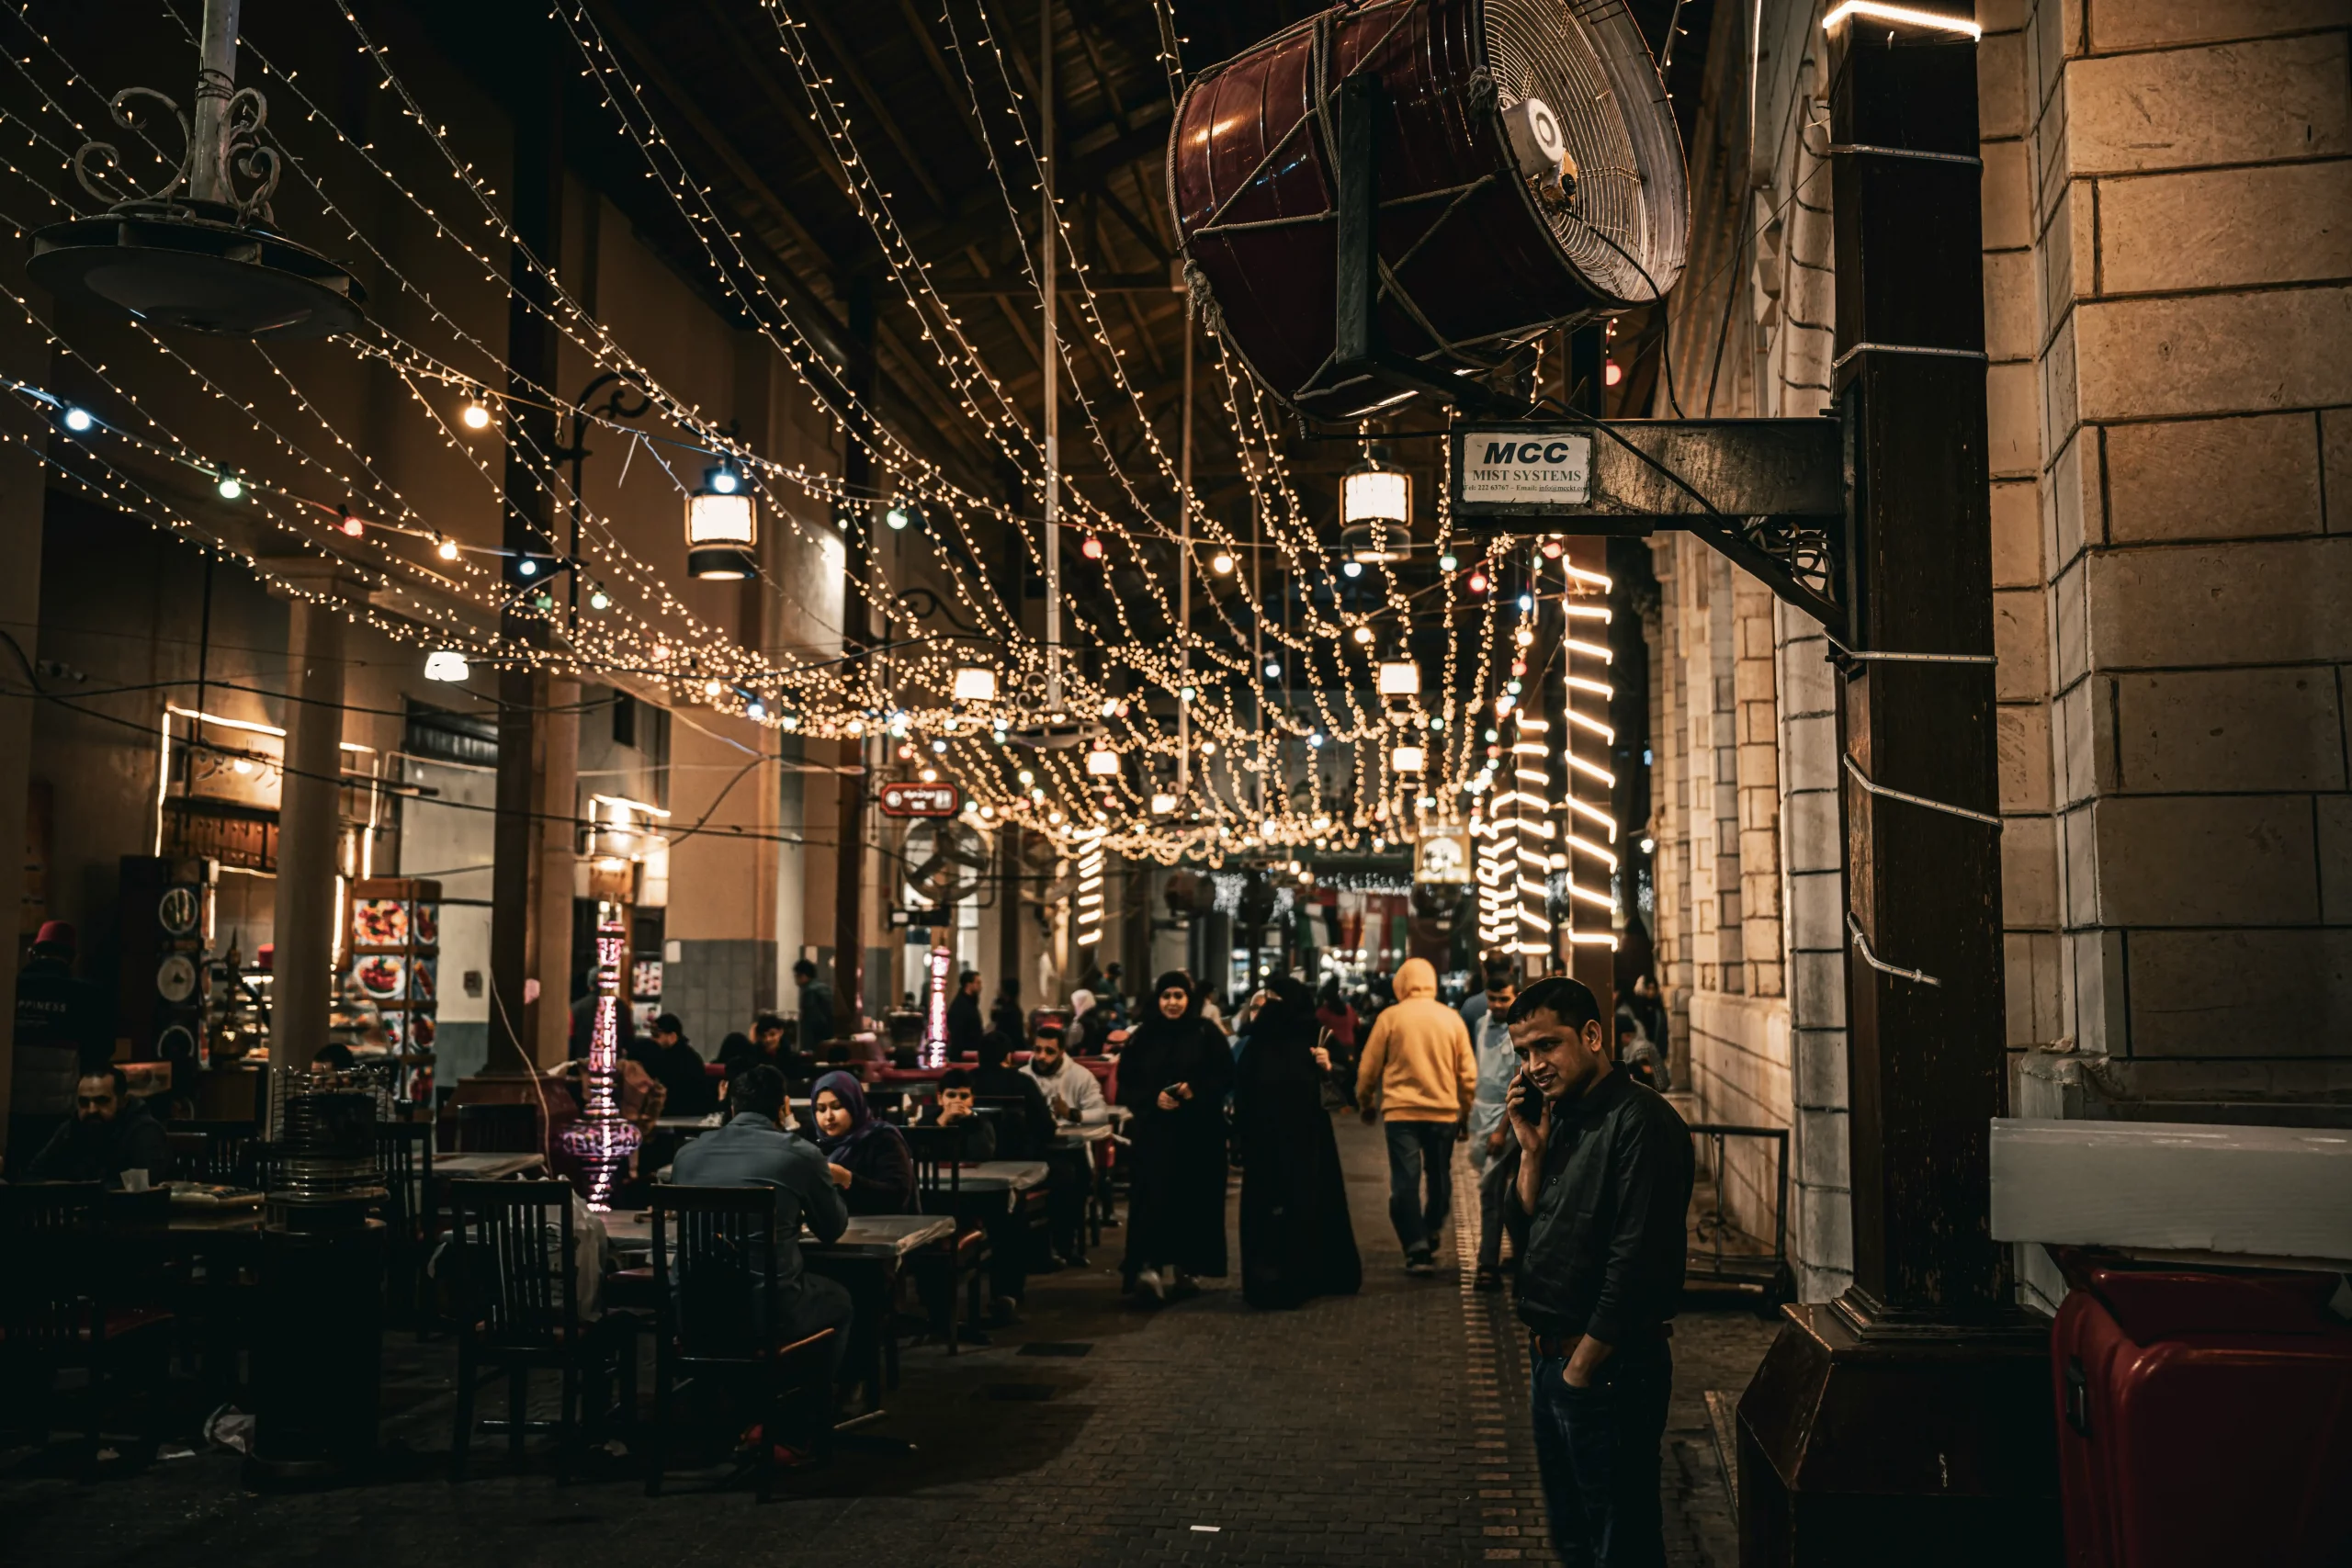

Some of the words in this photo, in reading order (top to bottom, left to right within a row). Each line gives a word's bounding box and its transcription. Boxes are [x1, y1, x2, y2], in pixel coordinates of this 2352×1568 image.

[1483, 442, 1569, 464] MCC
[1473, 469, 1510, 480] MIST
[1513, 469, 1581, 481] SYSTEMS
